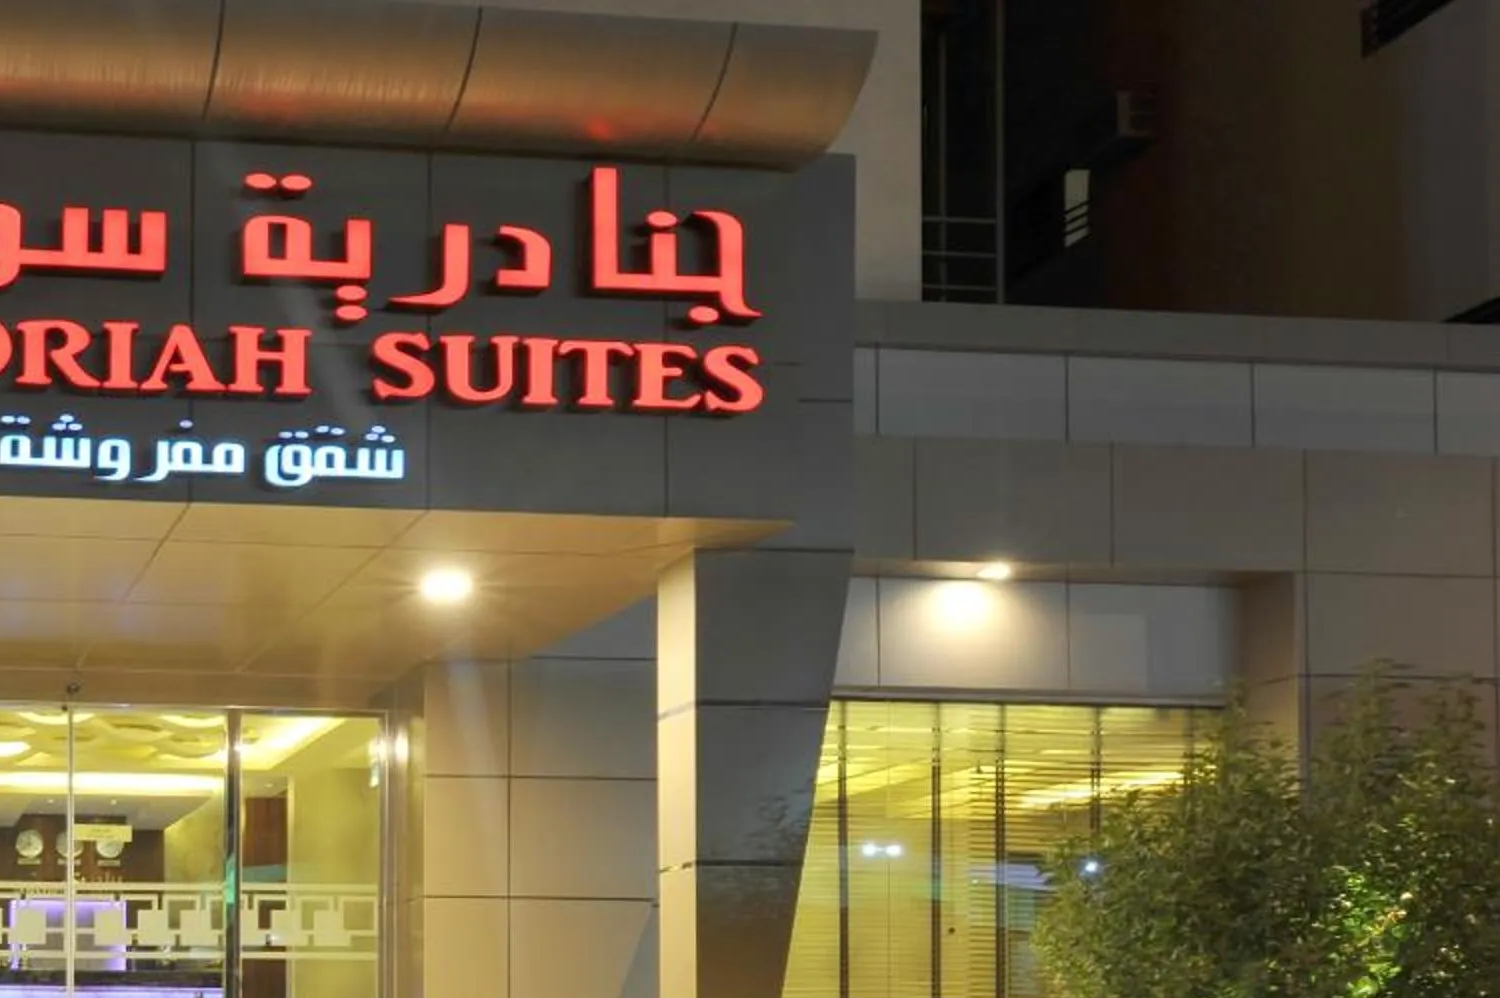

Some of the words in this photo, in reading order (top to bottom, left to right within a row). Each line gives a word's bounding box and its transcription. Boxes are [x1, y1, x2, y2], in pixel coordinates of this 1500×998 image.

[243, 166, 763, 323] جنادرية
[373, 330, 765, 412] SUITES
[264, 424, 406, 487] شقق
